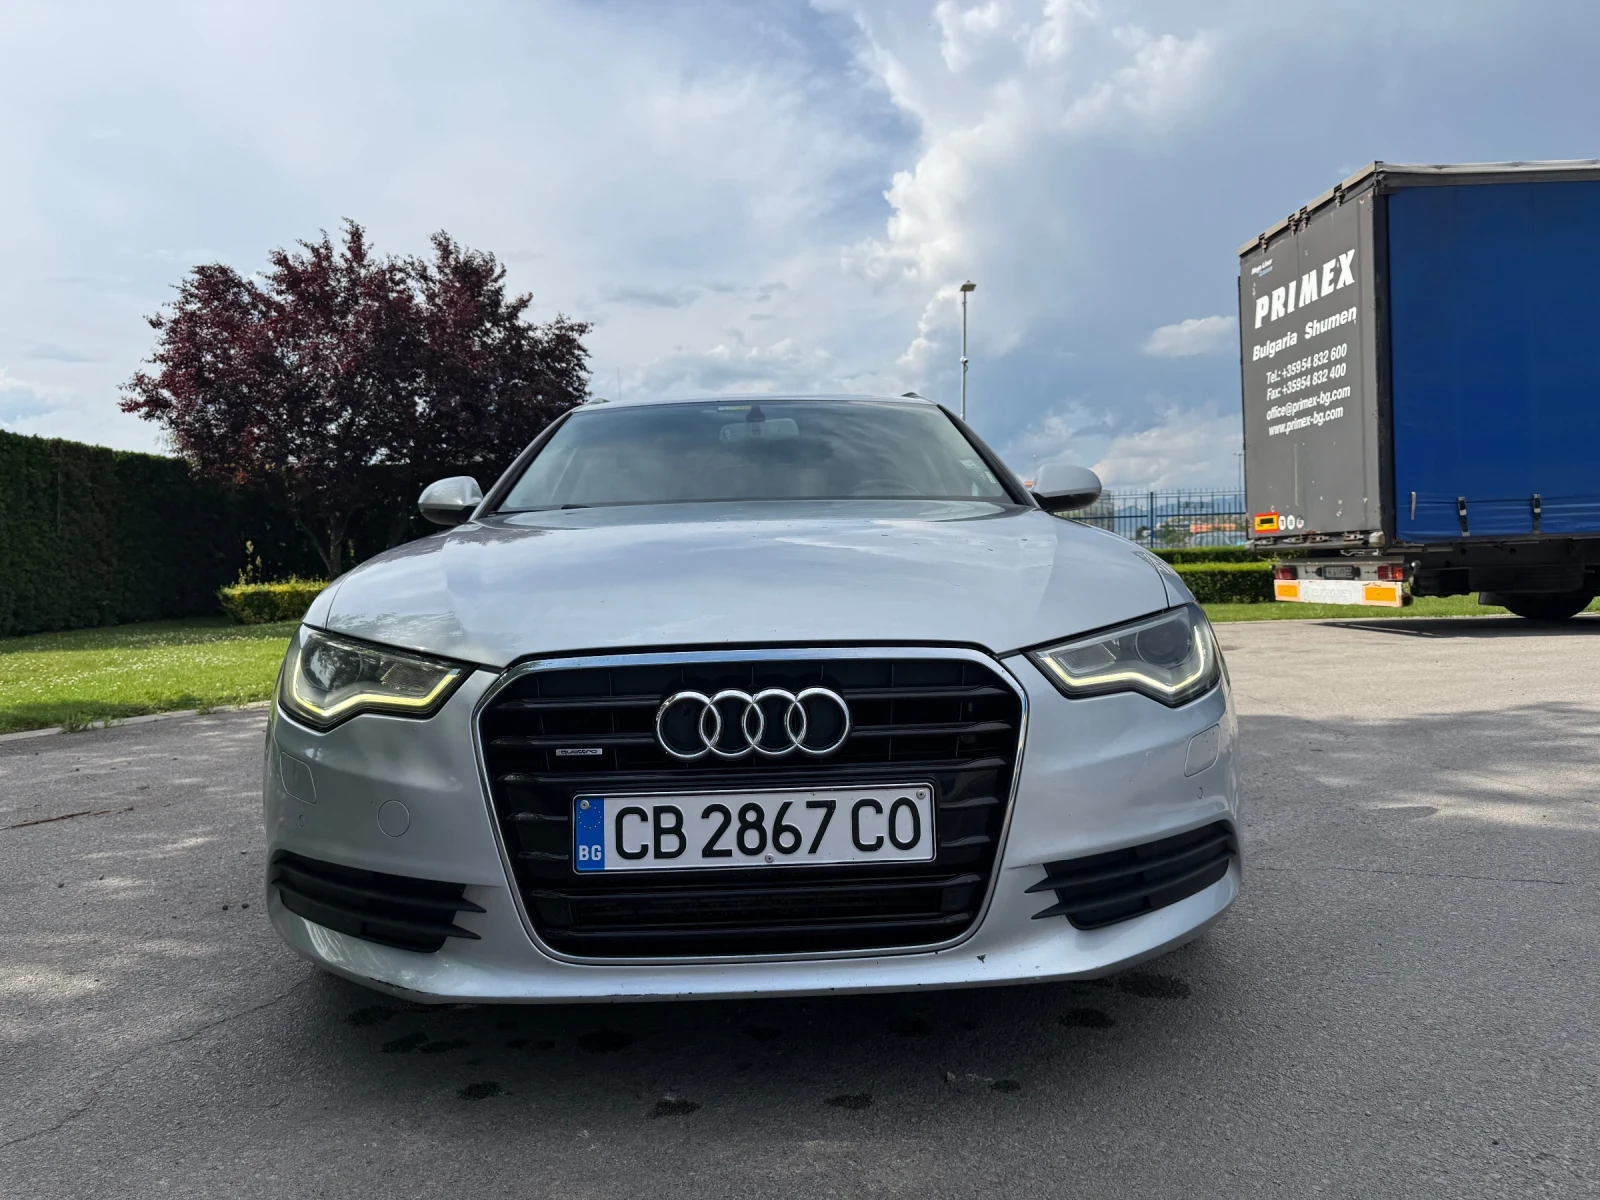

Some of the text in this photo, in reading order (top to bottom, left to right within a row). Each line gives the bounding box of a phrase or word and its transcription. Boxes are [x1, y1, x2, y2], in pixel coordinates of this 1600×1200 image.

[1255, 249, 1355, 329] PRIMEX
[1252, 306, 1357, 361] Bulgaria Shumen
[1282, 356, 1311, 378] +35954
[1313, 350, 1329, 367] 832
[1330, 343, 1347, 361] 600
[1282, 375, 1311, 395] +35954
[1312, 369, 1328, 385] 832
[1329, 363, 1346, 379] 400
[1266, 386, 1350, 420] office@primex-bg.com
[1268, 406, 1344, 436] www.primex-bg.com
[615, 796, 922, 860] CB 2867 CO
[578, 844, 602, 861] BG
